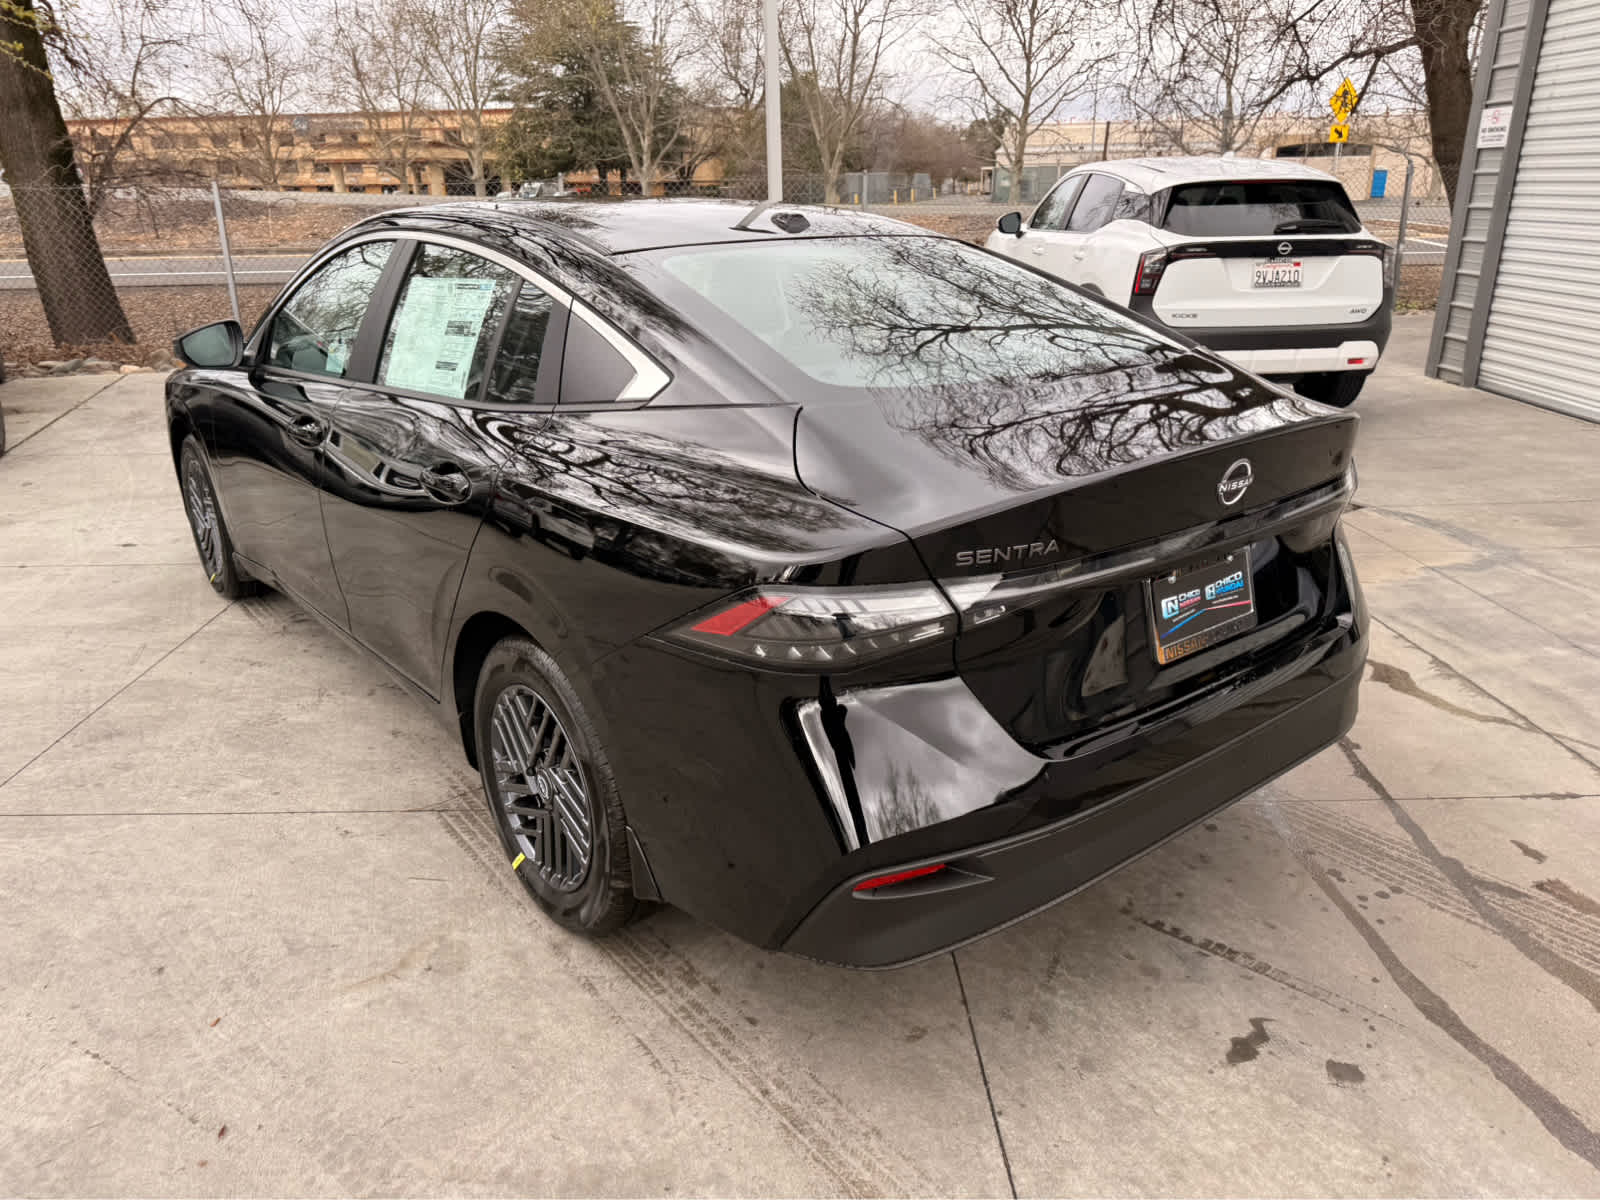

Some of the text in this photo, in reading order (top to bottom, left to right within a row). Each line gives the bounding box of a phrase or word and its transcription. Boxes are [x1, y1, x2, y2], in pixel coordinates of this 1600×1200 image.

[1255, 270, 1300, 282] 9VJA210
[955, 538, 1060, 567] SENTRA
[1215, 570, 1243, 589] CHICO
[1178, 588, 1201, 602] CHICO
